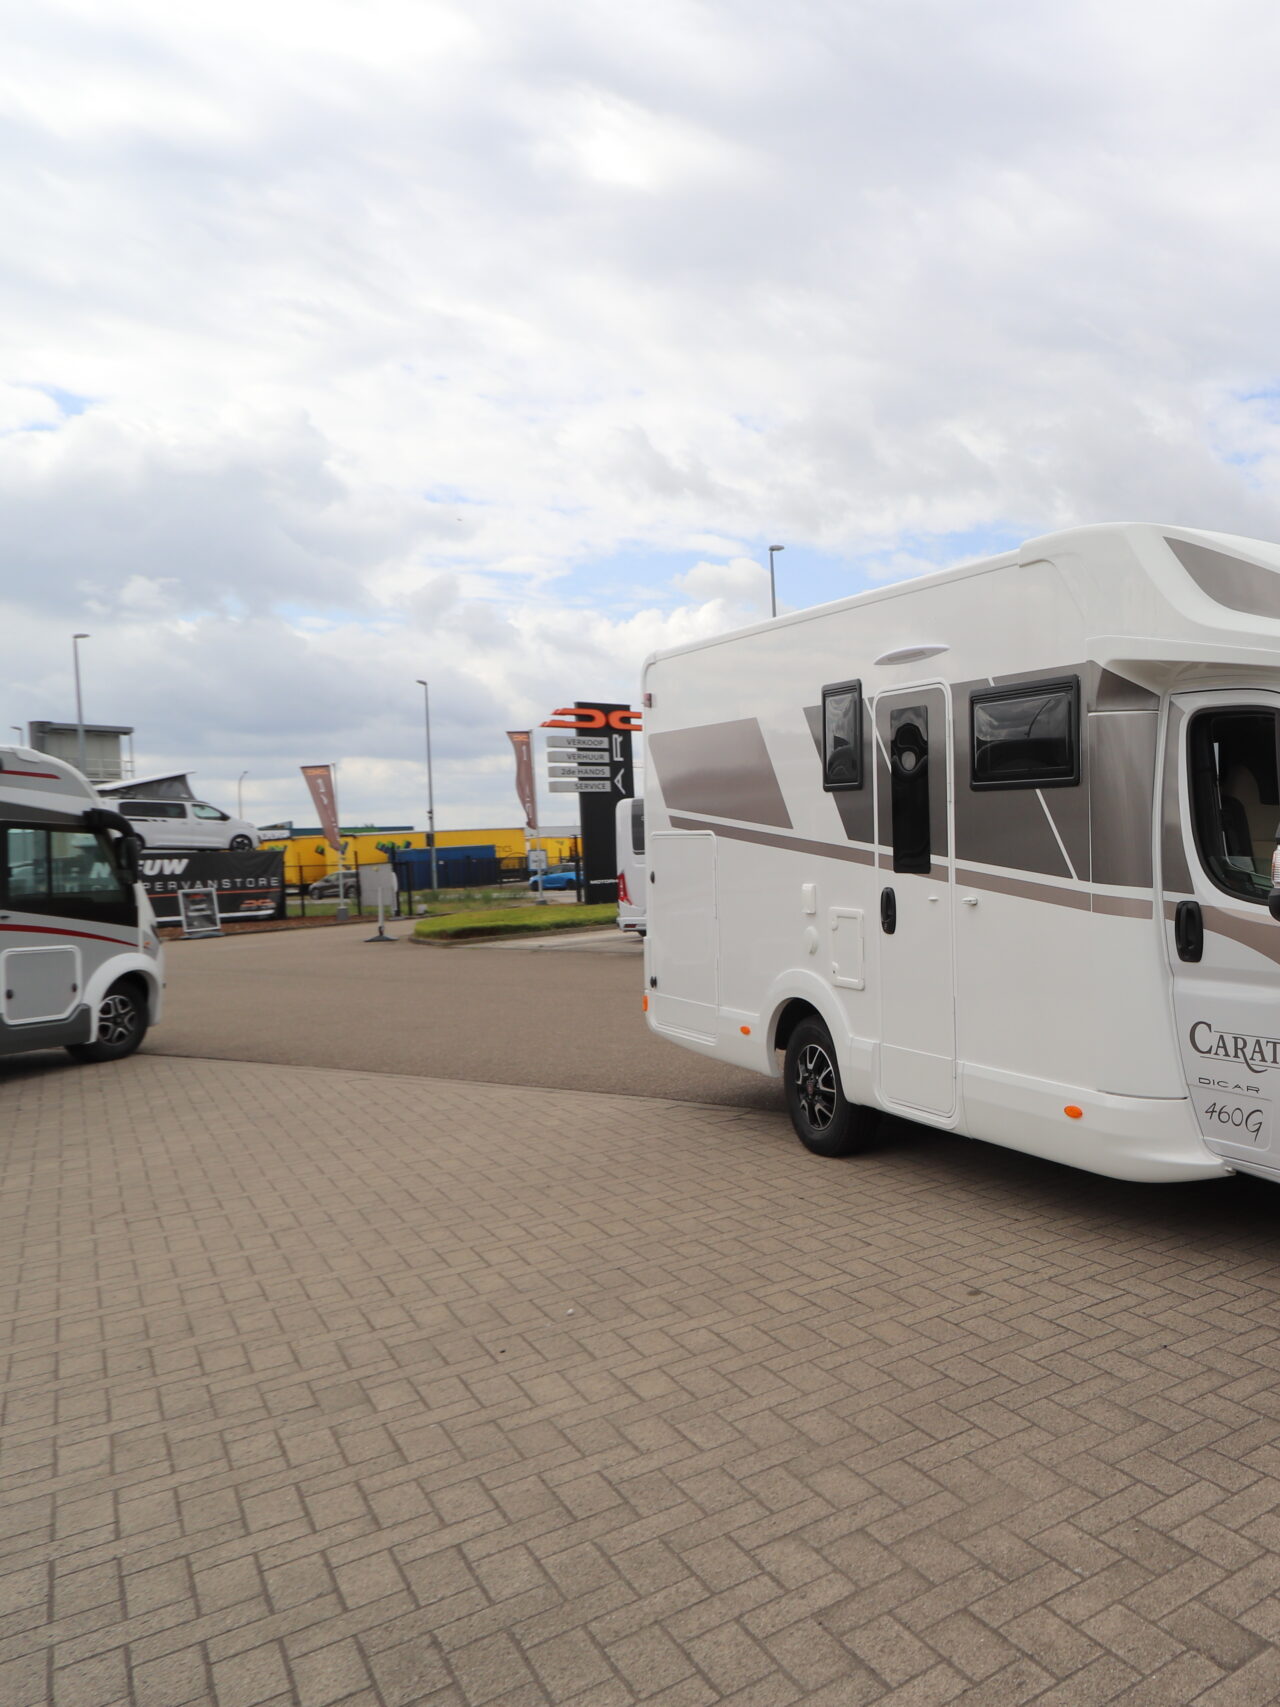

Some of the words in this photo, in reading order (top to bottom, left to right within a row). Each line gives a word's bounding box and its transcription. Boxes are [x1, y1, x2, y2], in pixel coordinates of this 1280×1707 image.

[566, 738, 604, 746] VERKOOP
[566, 753, 605, 761] VERHUUR
[560, 768, 576, 776] 2de
[577, 768, 606, 776] HANDS
[574, 782, 607, 790] SERVICE
[1198, 1077, 1261, 1094] DICAR
[1204, 1102, 1264, 1143] 460G
